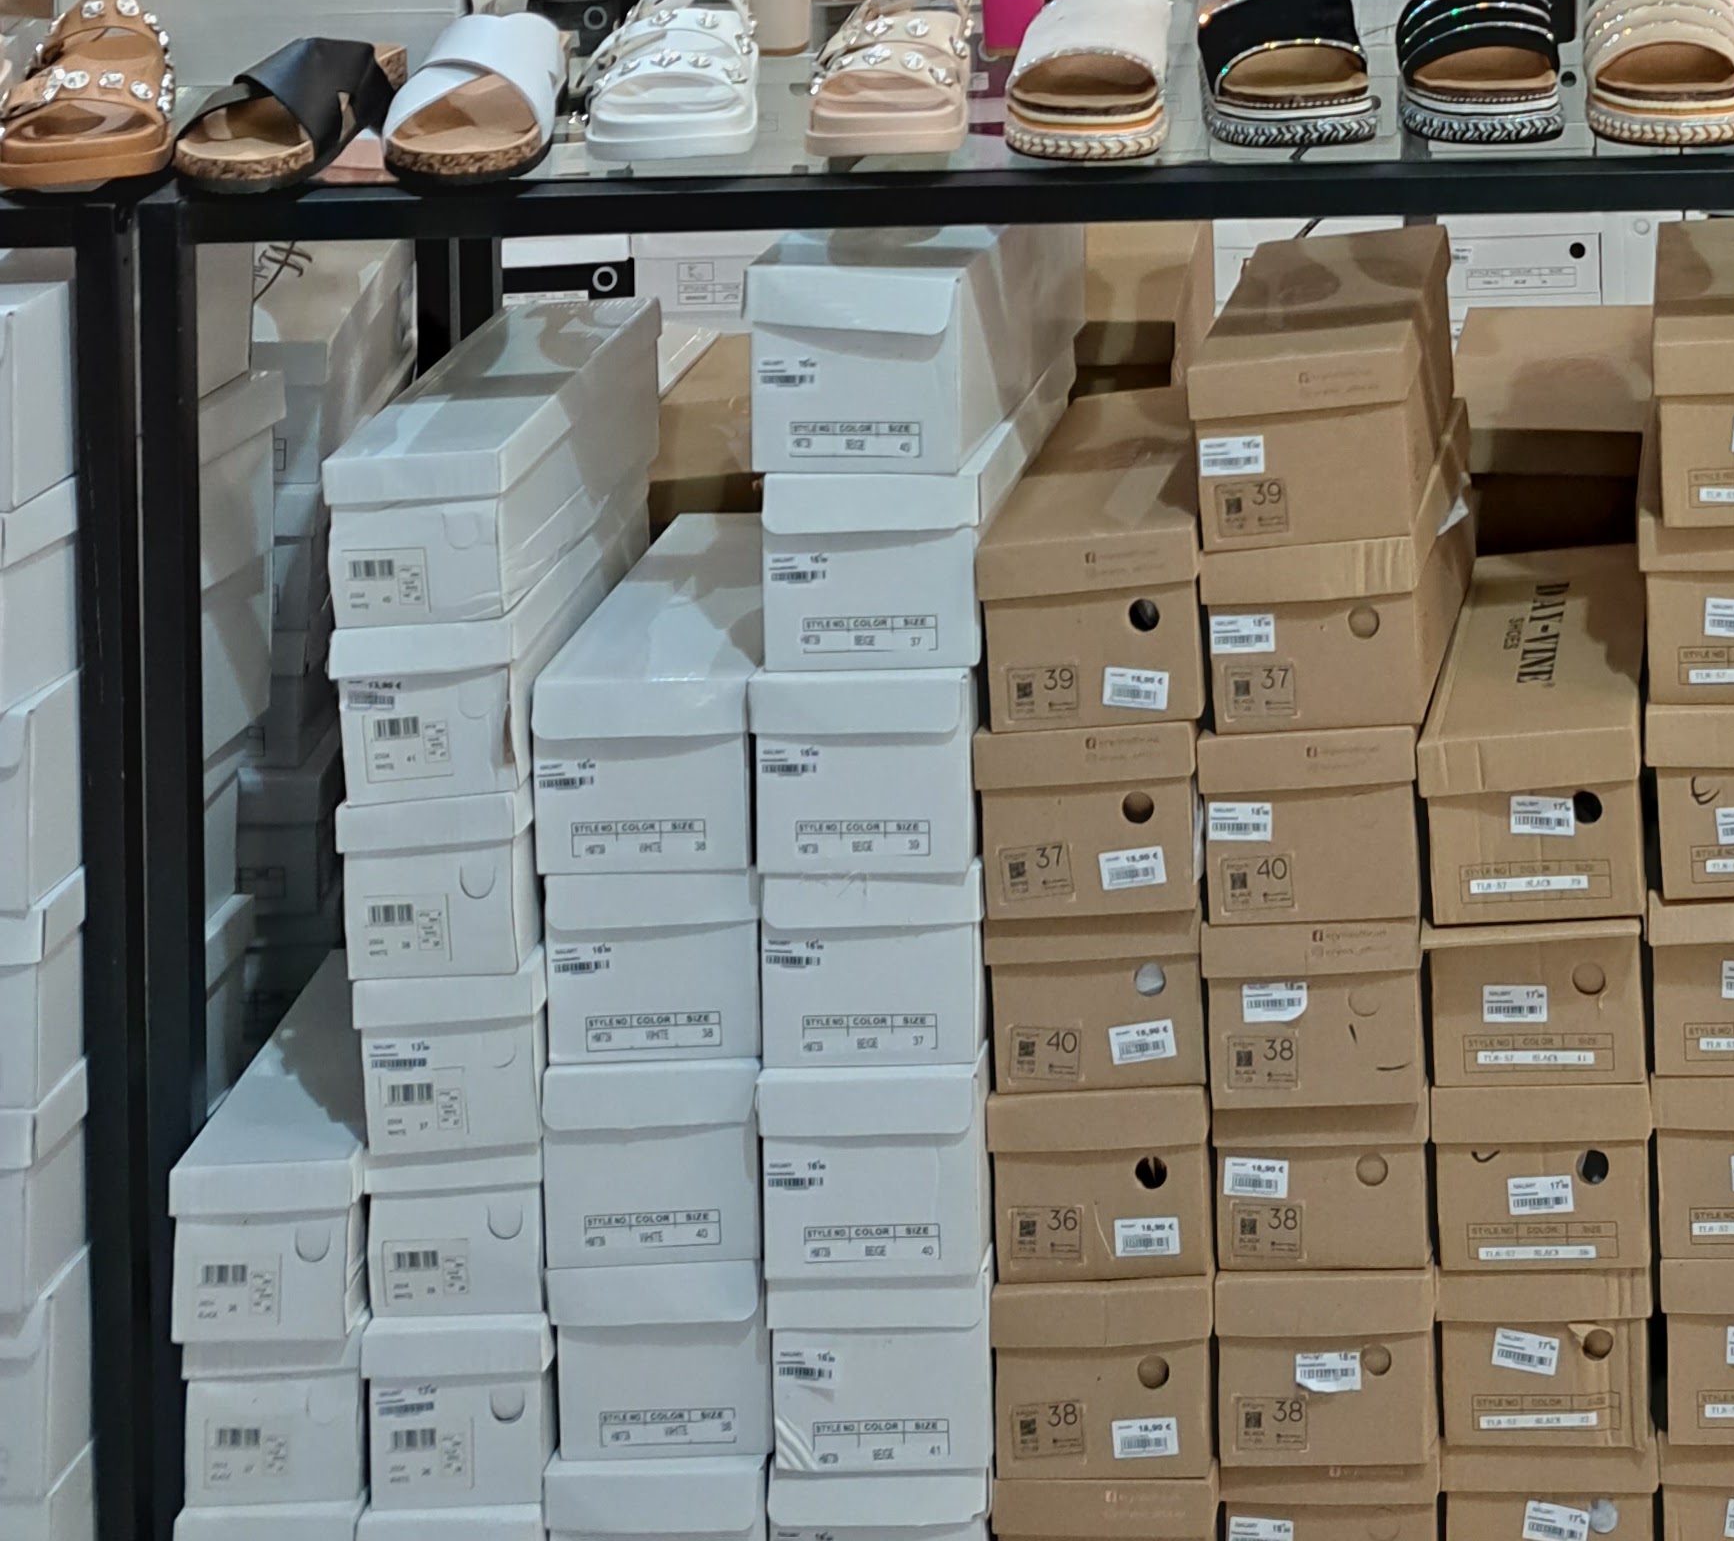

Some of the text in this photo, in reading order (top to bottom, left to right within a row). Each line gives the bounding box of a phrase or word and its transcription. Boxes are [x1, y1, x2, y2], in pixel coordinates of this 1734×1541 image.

[1252, 482, 1283, 507] 39
[1043, 668, 1075, 692] 39
[1261, 667, 1289, 690] 37
[1036, 844, 1064, 869] 37
[1256, 858, 1288, 882] 40
[912, 1036, 924, 1047] 37
[1046, 1031, 1078, 1055] 40
[1263, 1038, 1295, 1062] 38
[1047, 1208, 1079, 1232] 36
[1267, 1207, 1299, 1232] 38
[697, 1228, 709, 1239] 40
[921, 1245, 934, 1257] 40
[1047, 1403, 1079, 1428] 38
[1272, 1400, 1304, 1424] 38
